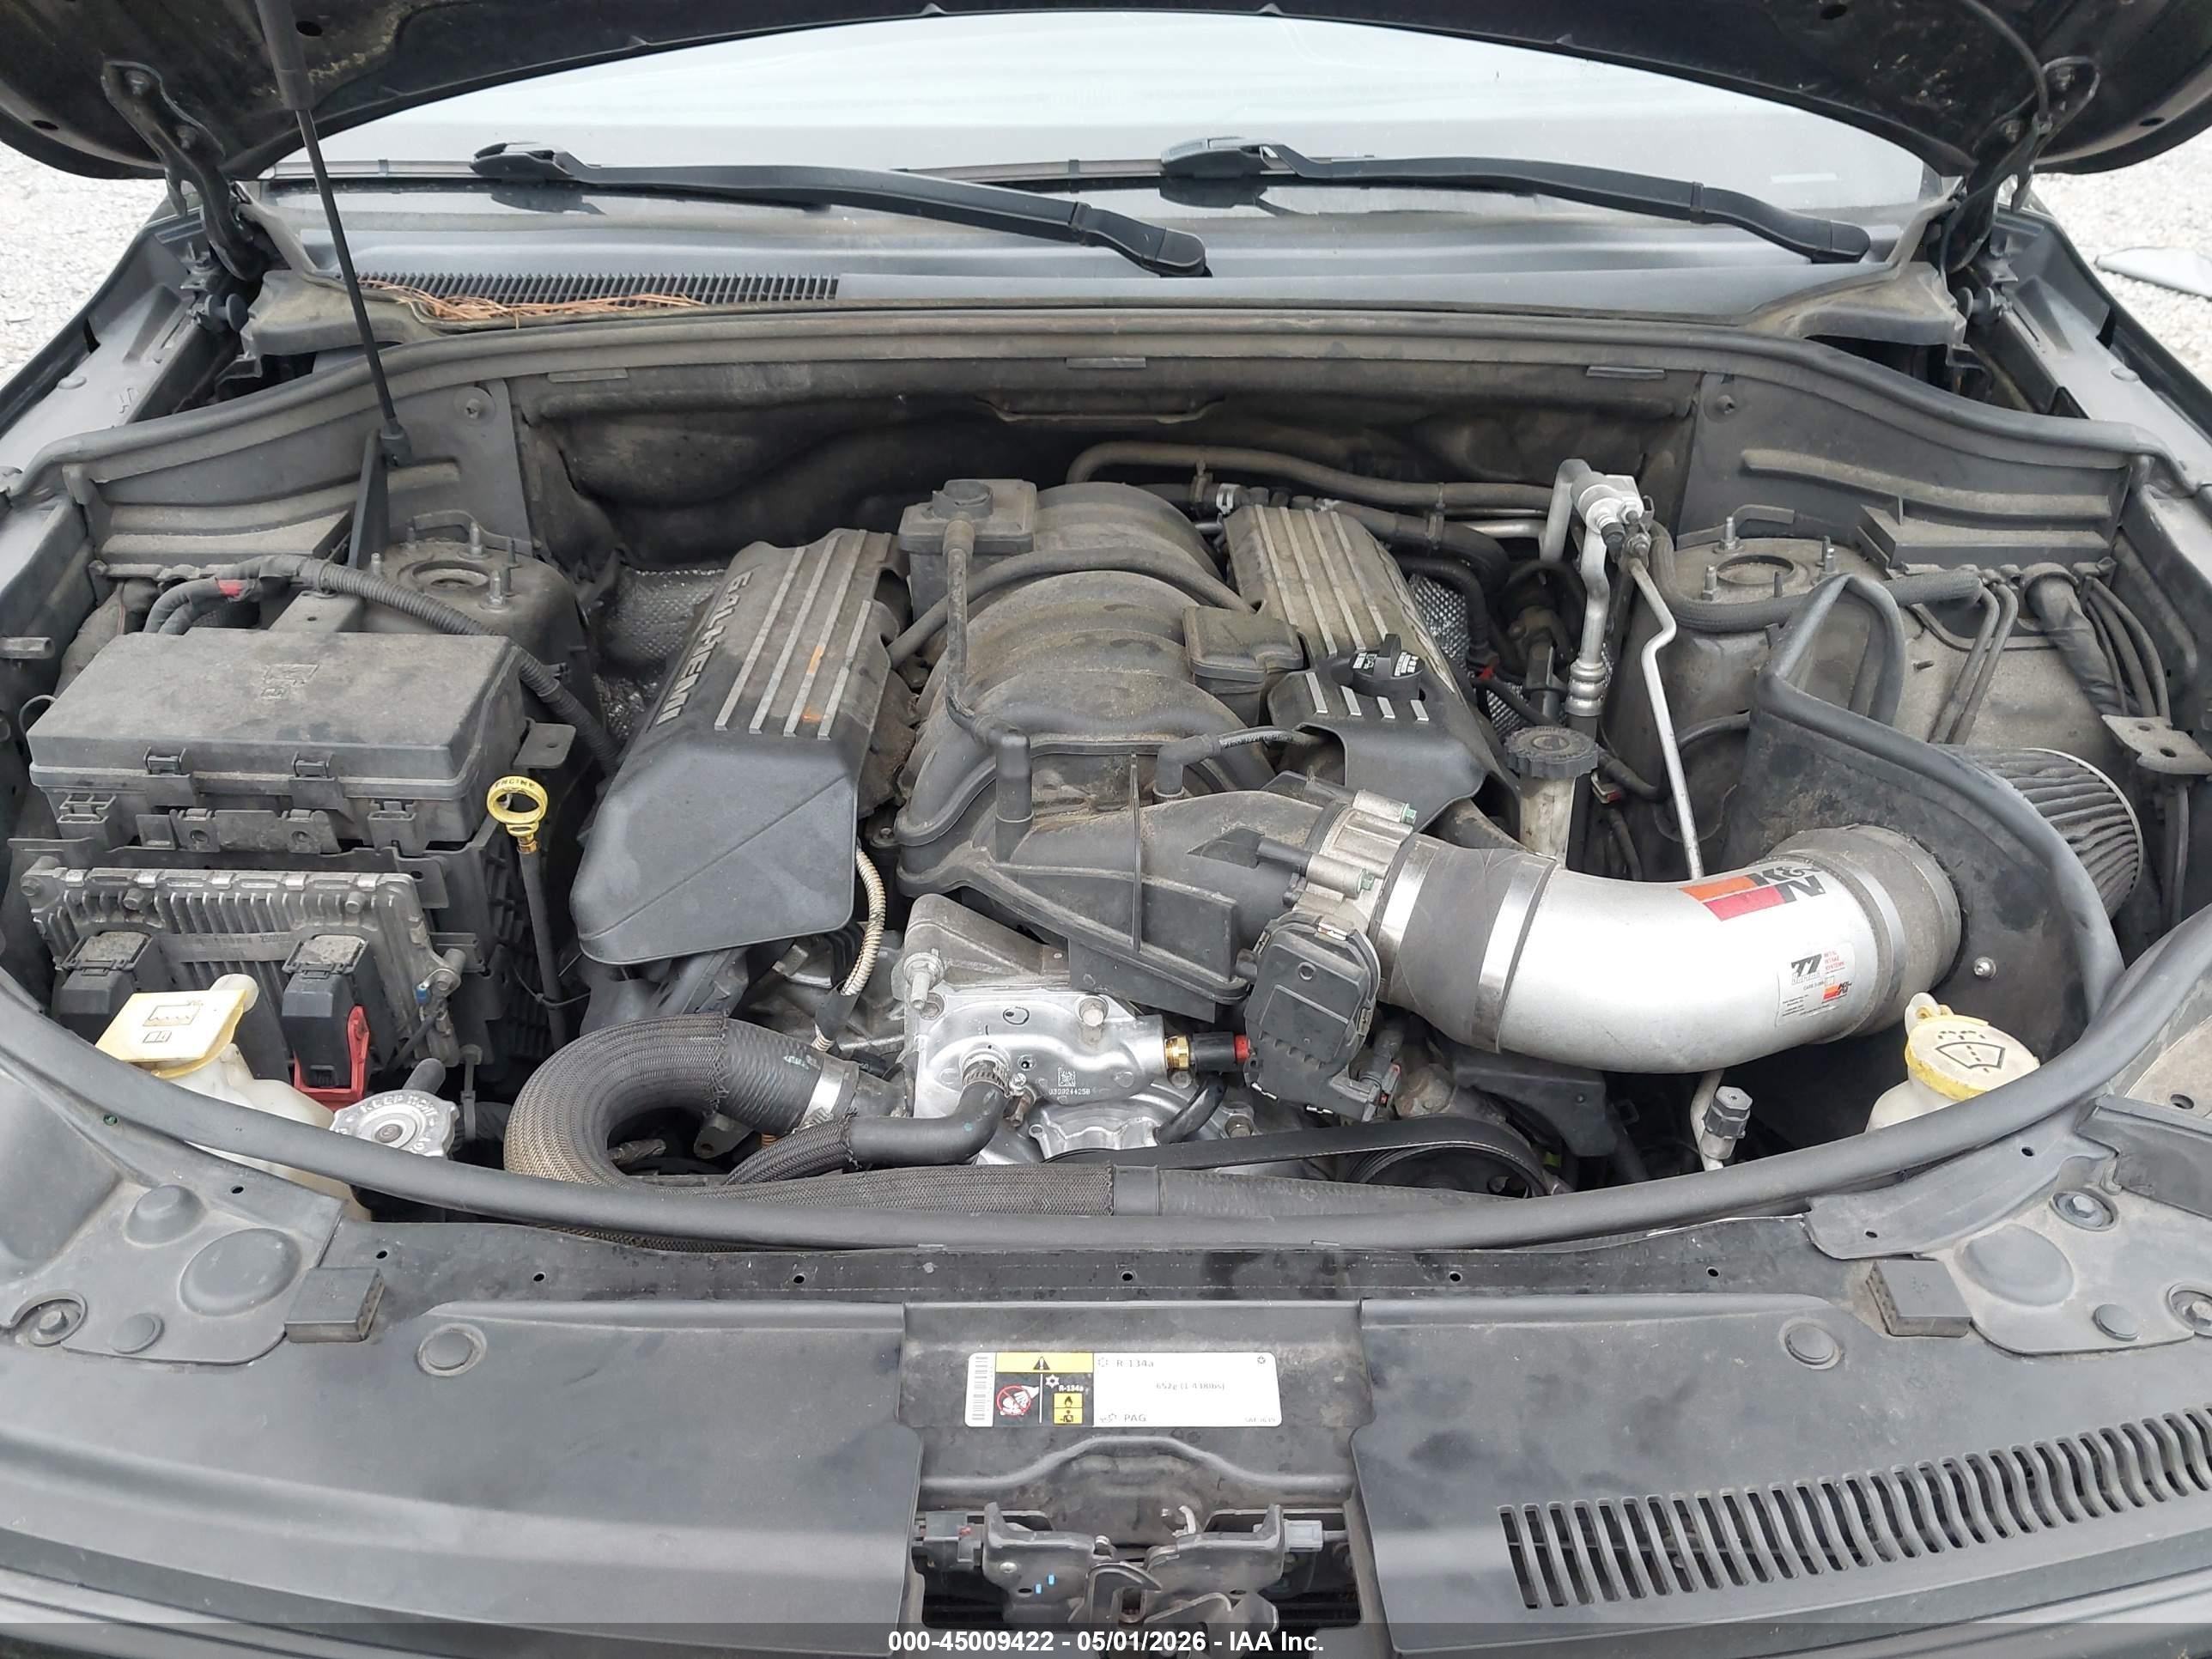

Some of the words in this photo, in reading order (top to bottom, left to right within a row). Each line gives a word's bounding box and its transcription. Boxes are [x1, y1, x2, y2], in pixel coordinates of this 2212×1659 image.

[655, 624, 727, 727] HEMI
[1746, 865, 1826, 902] K&N
[1790, 953, 1822, 977] 77
[360, 1094, 404, 1113] KEEP
[1123, 1413, 1147, 1423] PAG
